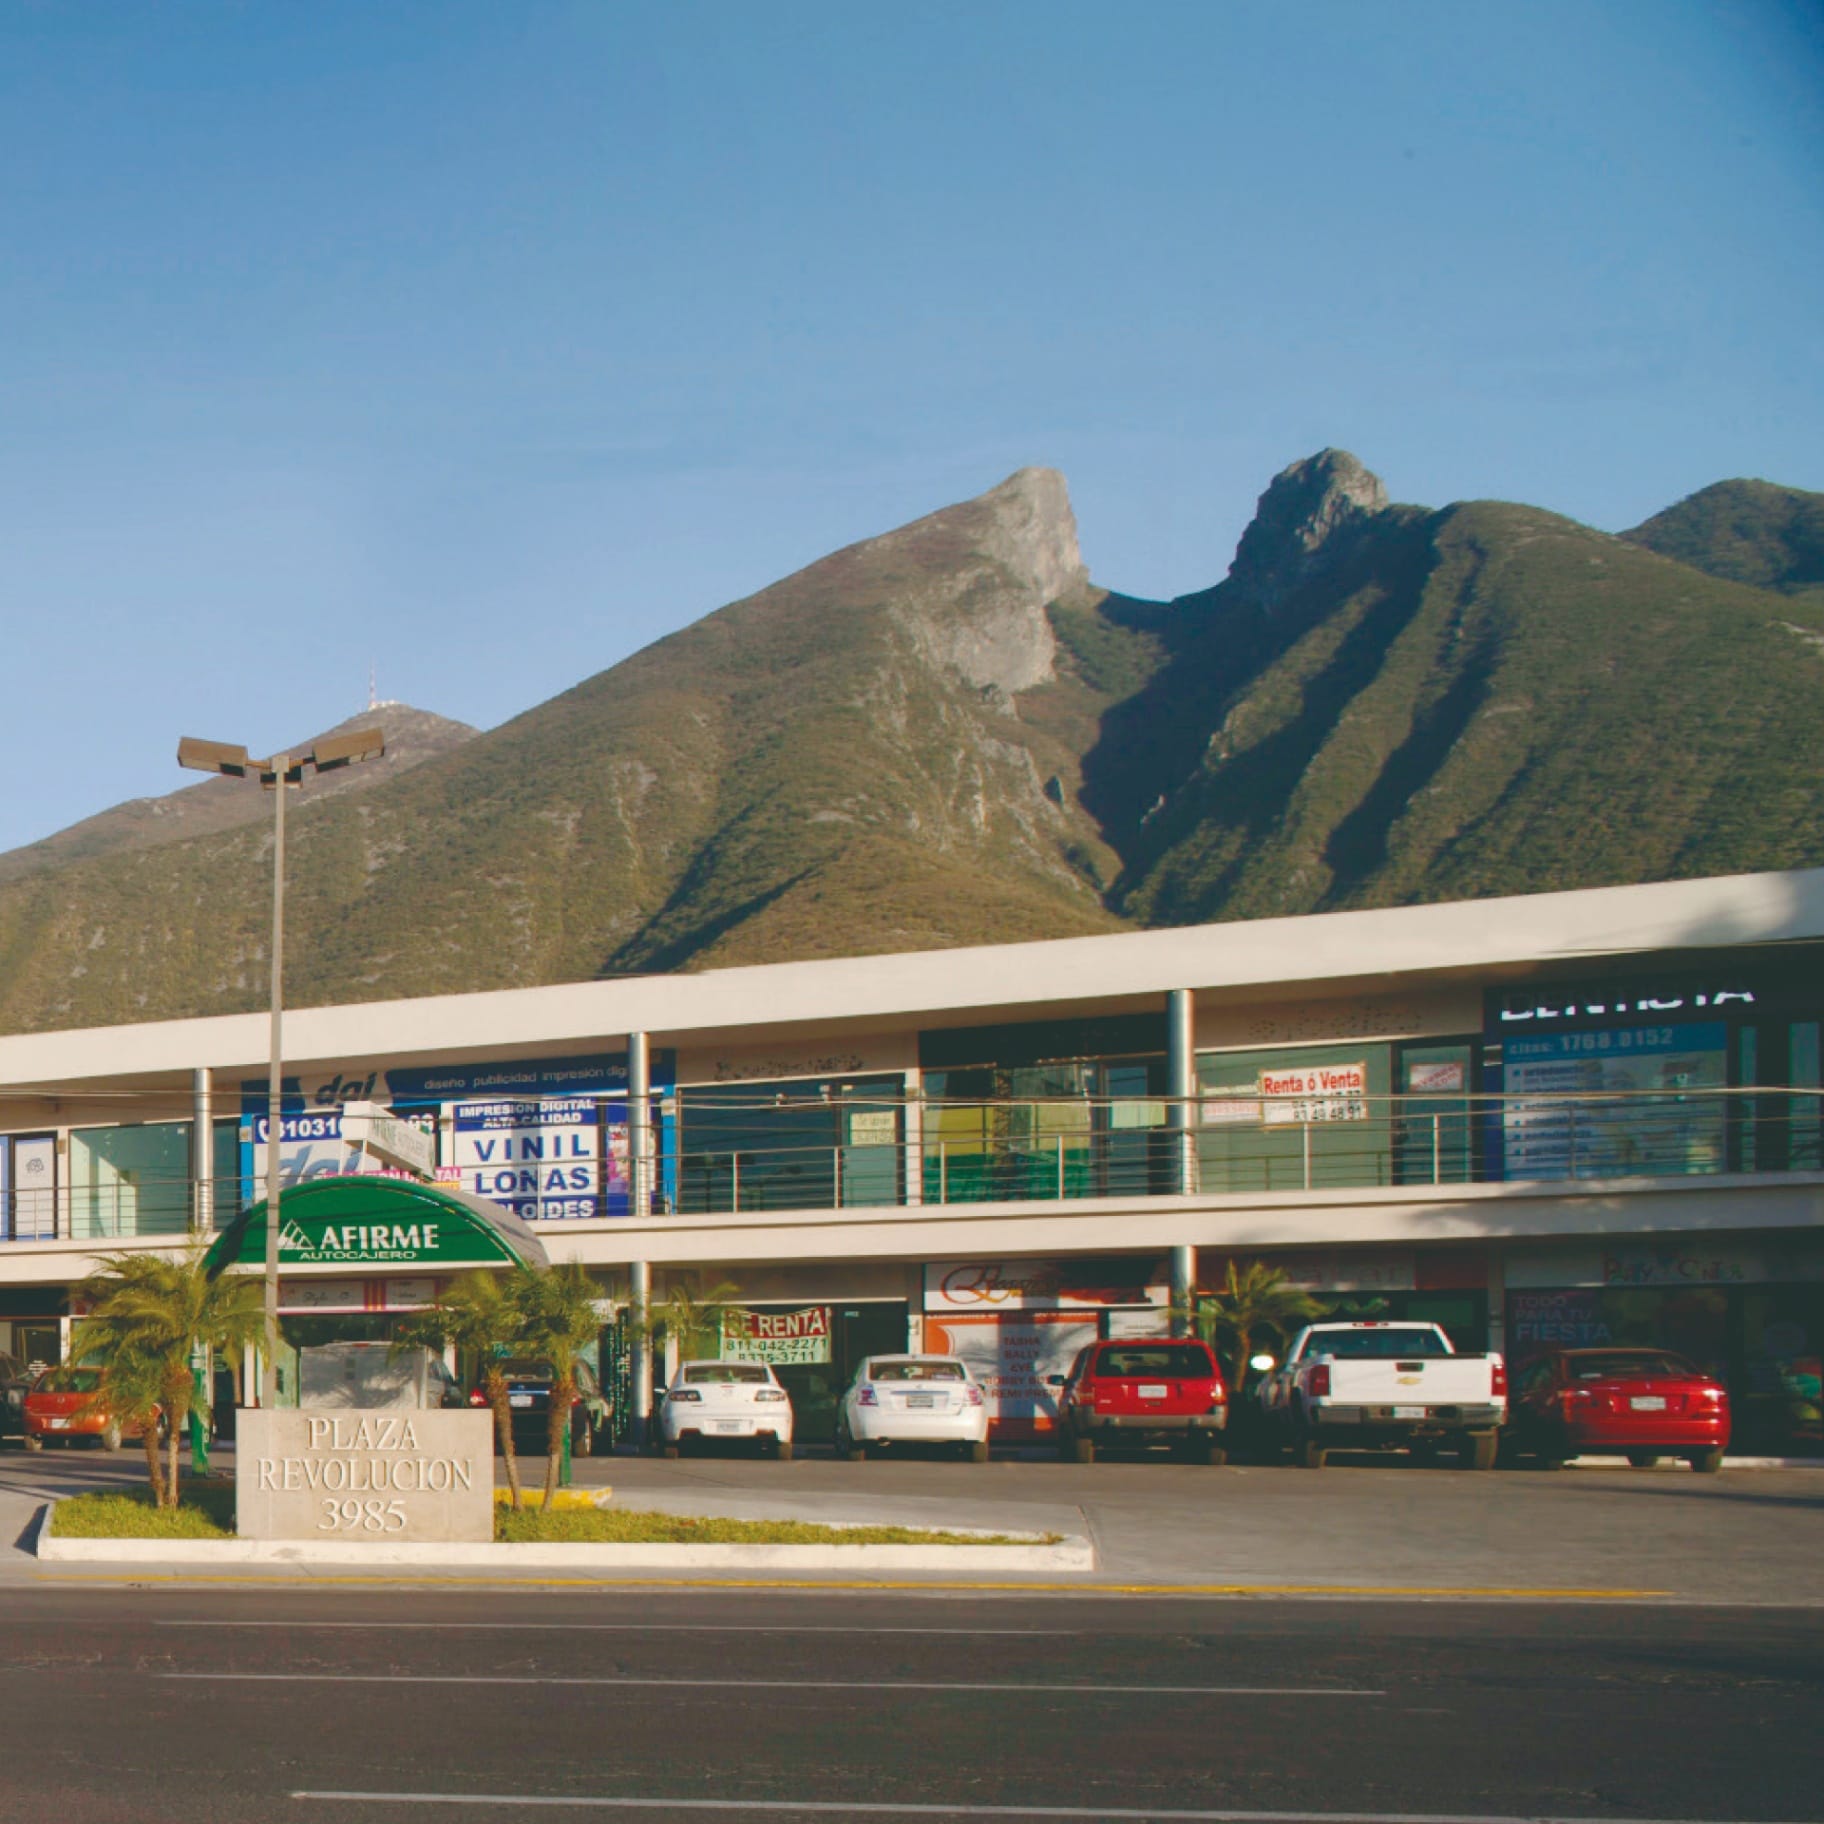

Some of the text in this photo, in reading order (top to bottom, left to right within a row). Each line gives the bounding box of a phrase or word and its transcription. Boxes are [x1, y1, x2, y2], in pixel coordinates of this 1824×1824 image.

[473, 1070, 537, 1089] publicidad
[1263, 1076, 1303, 1094] Renta
[1319, 1070, 1361, 1089] Venta
[459, 1099, 596, 1118] IMPRESION DIGITAL
[473, 1133, 590, 1162] VINIL
[474, 1166, 590, 1194] LONAS
[319, 1223, 440, 1250] AFIRME
[299, 1250, 418, 1260] AUTOCAJERO
[758, 1307, 825, 1337] RENTA
[1515, 1322, 1614, 1342] FIESTA
[306, 1416, 420, 1451] PLAZA
[256, 1457, 473, 1492] REVOLUCION
[316, 1497, 408, 1532] 3985
